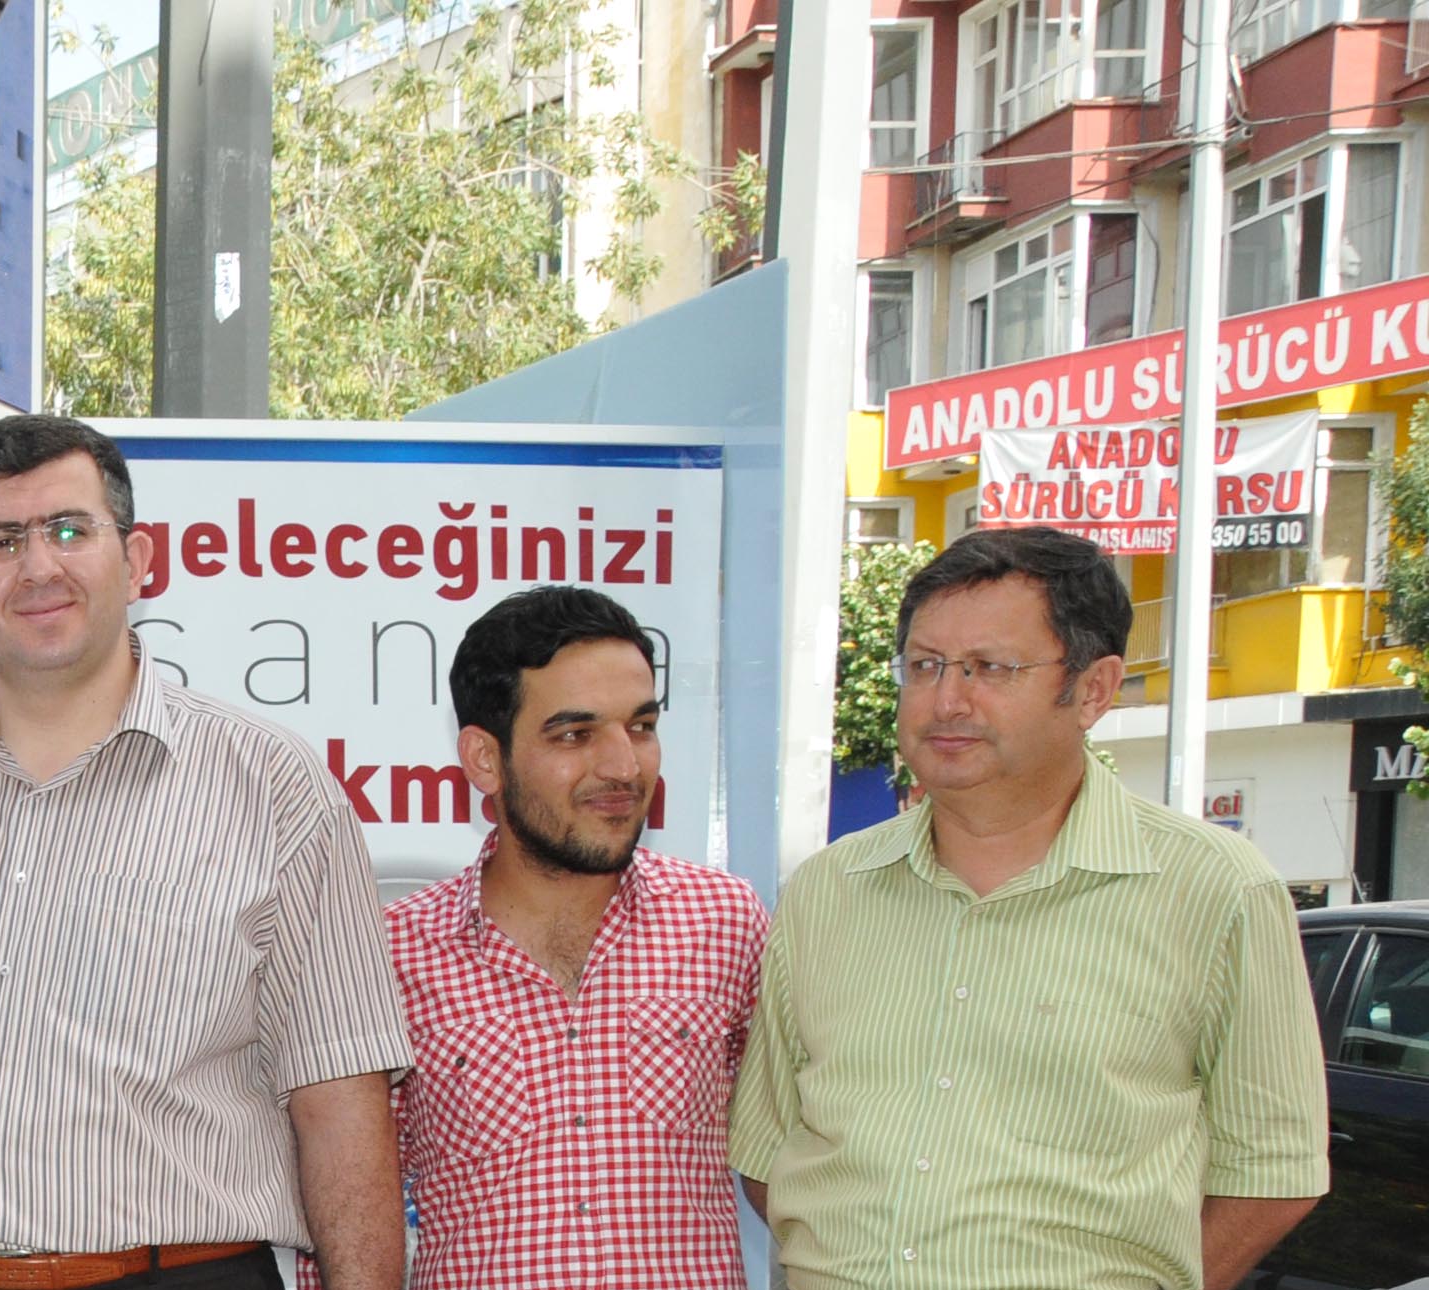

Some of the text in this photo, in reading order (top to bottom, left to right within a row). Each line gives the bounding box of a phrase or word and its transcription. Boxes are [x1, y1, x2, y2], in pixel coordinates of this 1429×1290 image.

[900, 365, 1115, 456] ANADOLU
[1047, 427, 1239, 470] ANADOU
[980, 470, 1303, 520] SÜRÜCÜ KRSU
[1248, 522, 1272, 546] 55
[1275, 520, 1303, 545] 00
